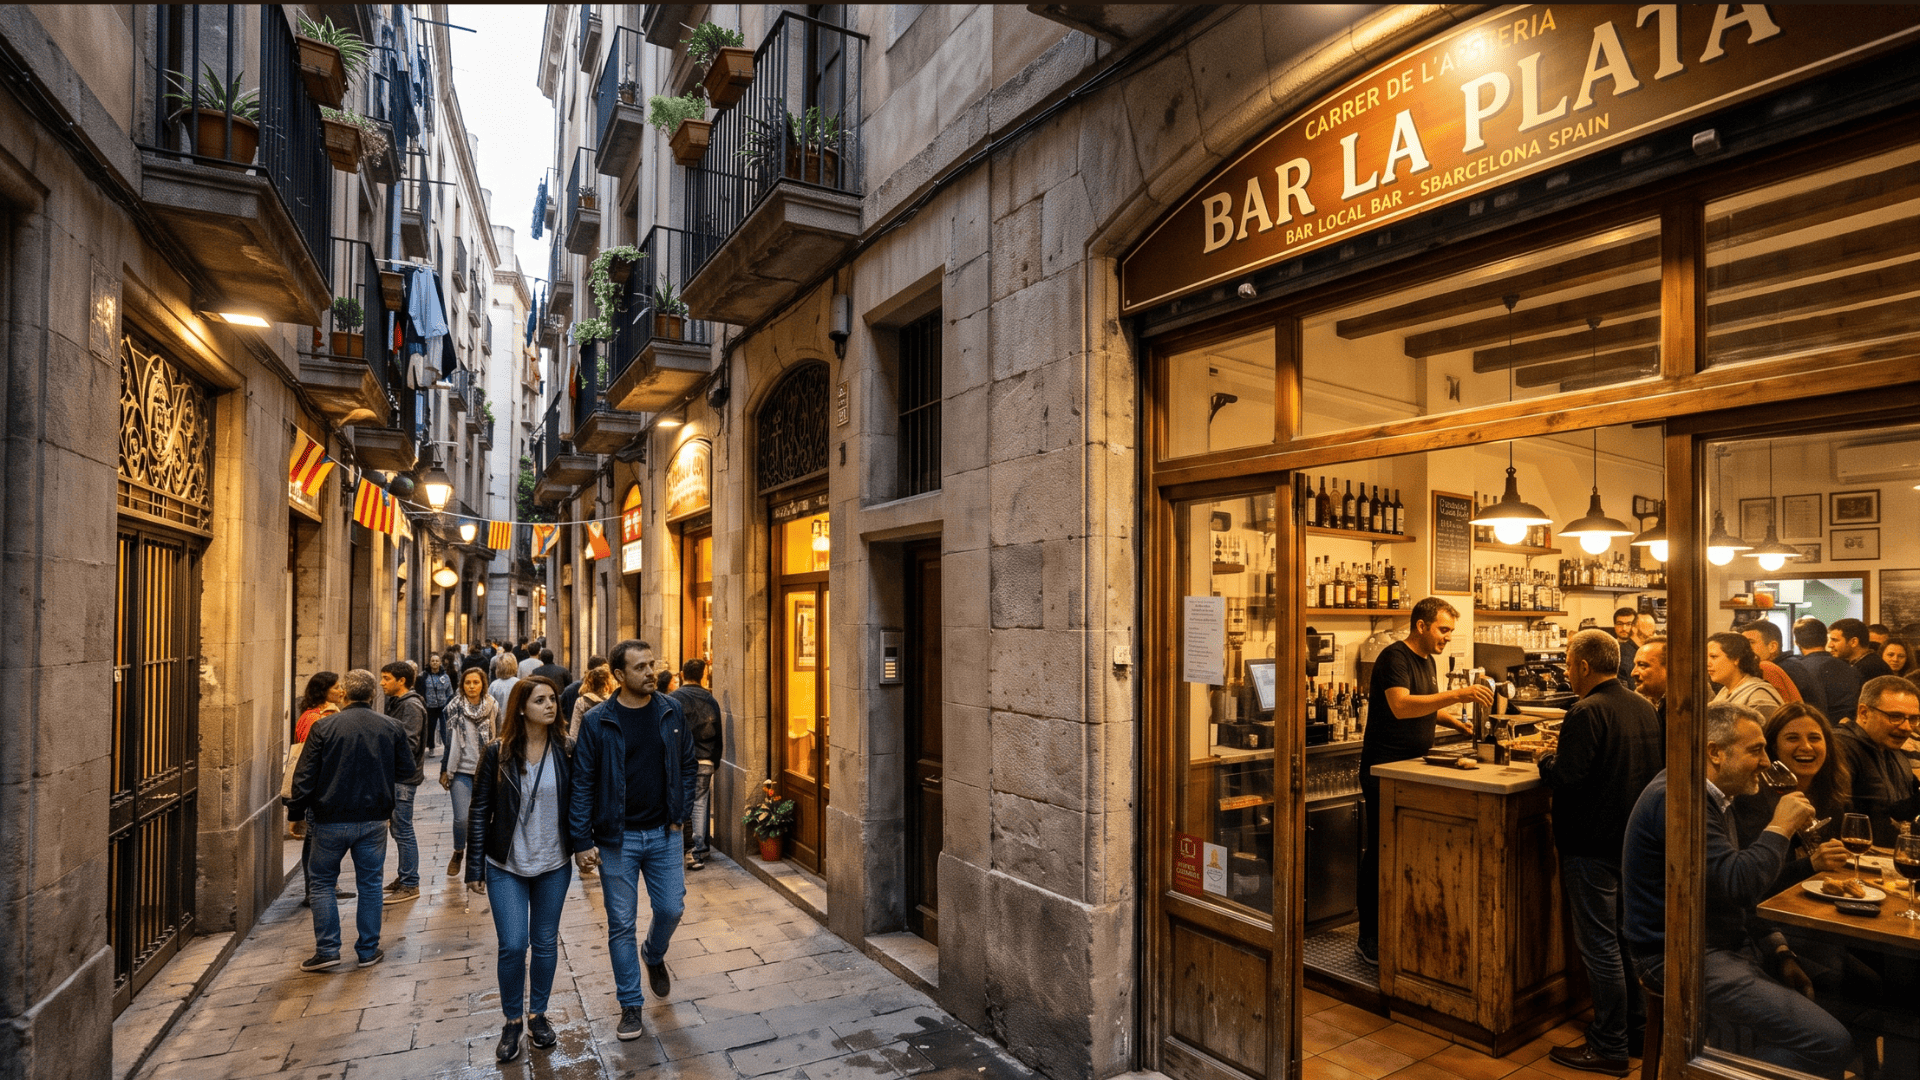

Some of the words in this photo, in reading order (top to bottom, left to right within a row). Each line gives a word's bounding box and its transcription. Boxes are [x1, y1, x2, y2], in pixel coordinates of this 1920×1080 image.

[1202, 157, 1315, 253] BAR
[1341, 108, 1430, 200] LA
[1460, 4, 1781, 153] PLATA
[1305, 87, 1380, 140] CARRER
[1387, 68, 1414, 100] DE
[1286, 223, 1313, 245] BAR
[1318, 204, 1365, 233] LOCAL
[1371, 190, 1402, 214] BAR
[1420, 139, 1541, 196] SBARCELONA
[1549, 113, 1609, 150] SPAIN
